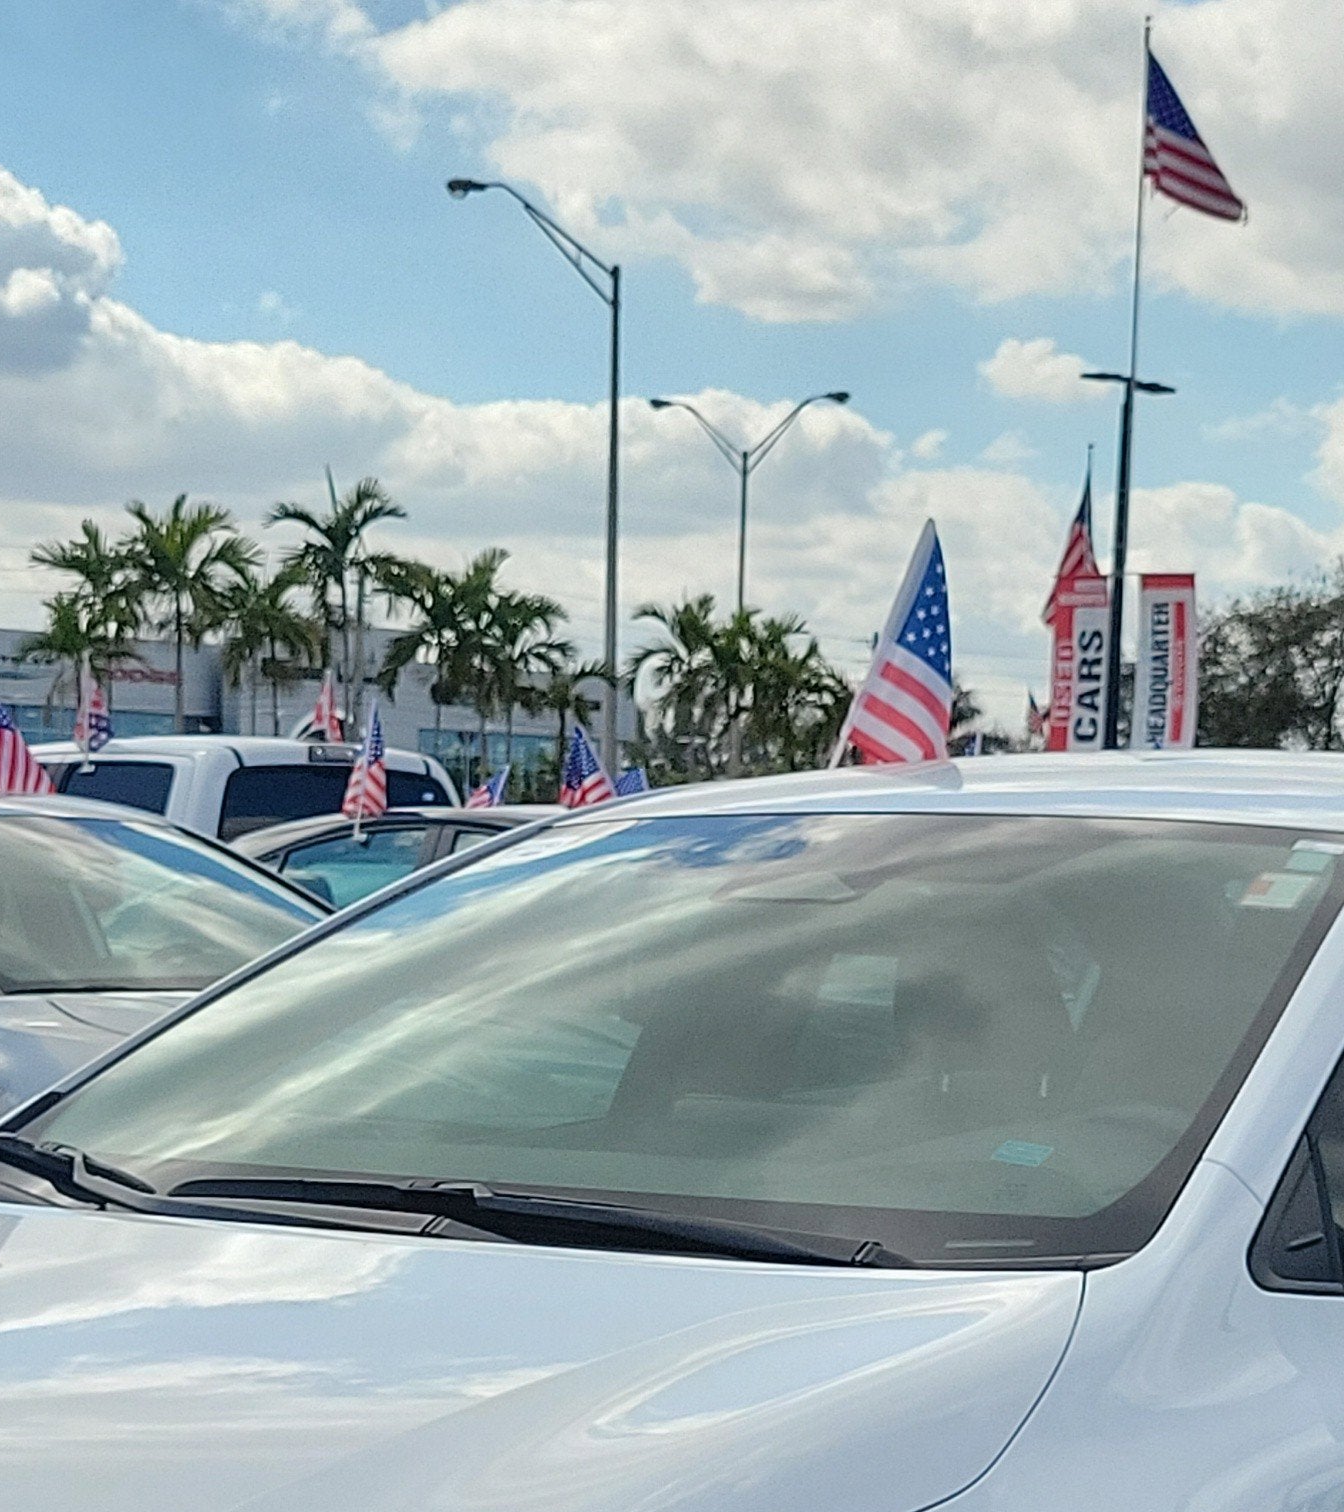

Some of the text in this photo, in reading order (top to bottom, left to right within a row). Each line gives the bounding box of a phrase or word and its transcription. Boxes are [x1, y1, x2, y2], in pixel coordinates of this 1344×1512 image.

[1053, 645, 1073, 724] USED
[1074, 630, 1103, 743] CARS
[1147, 603, 1170, 744] HEADQUARTER
